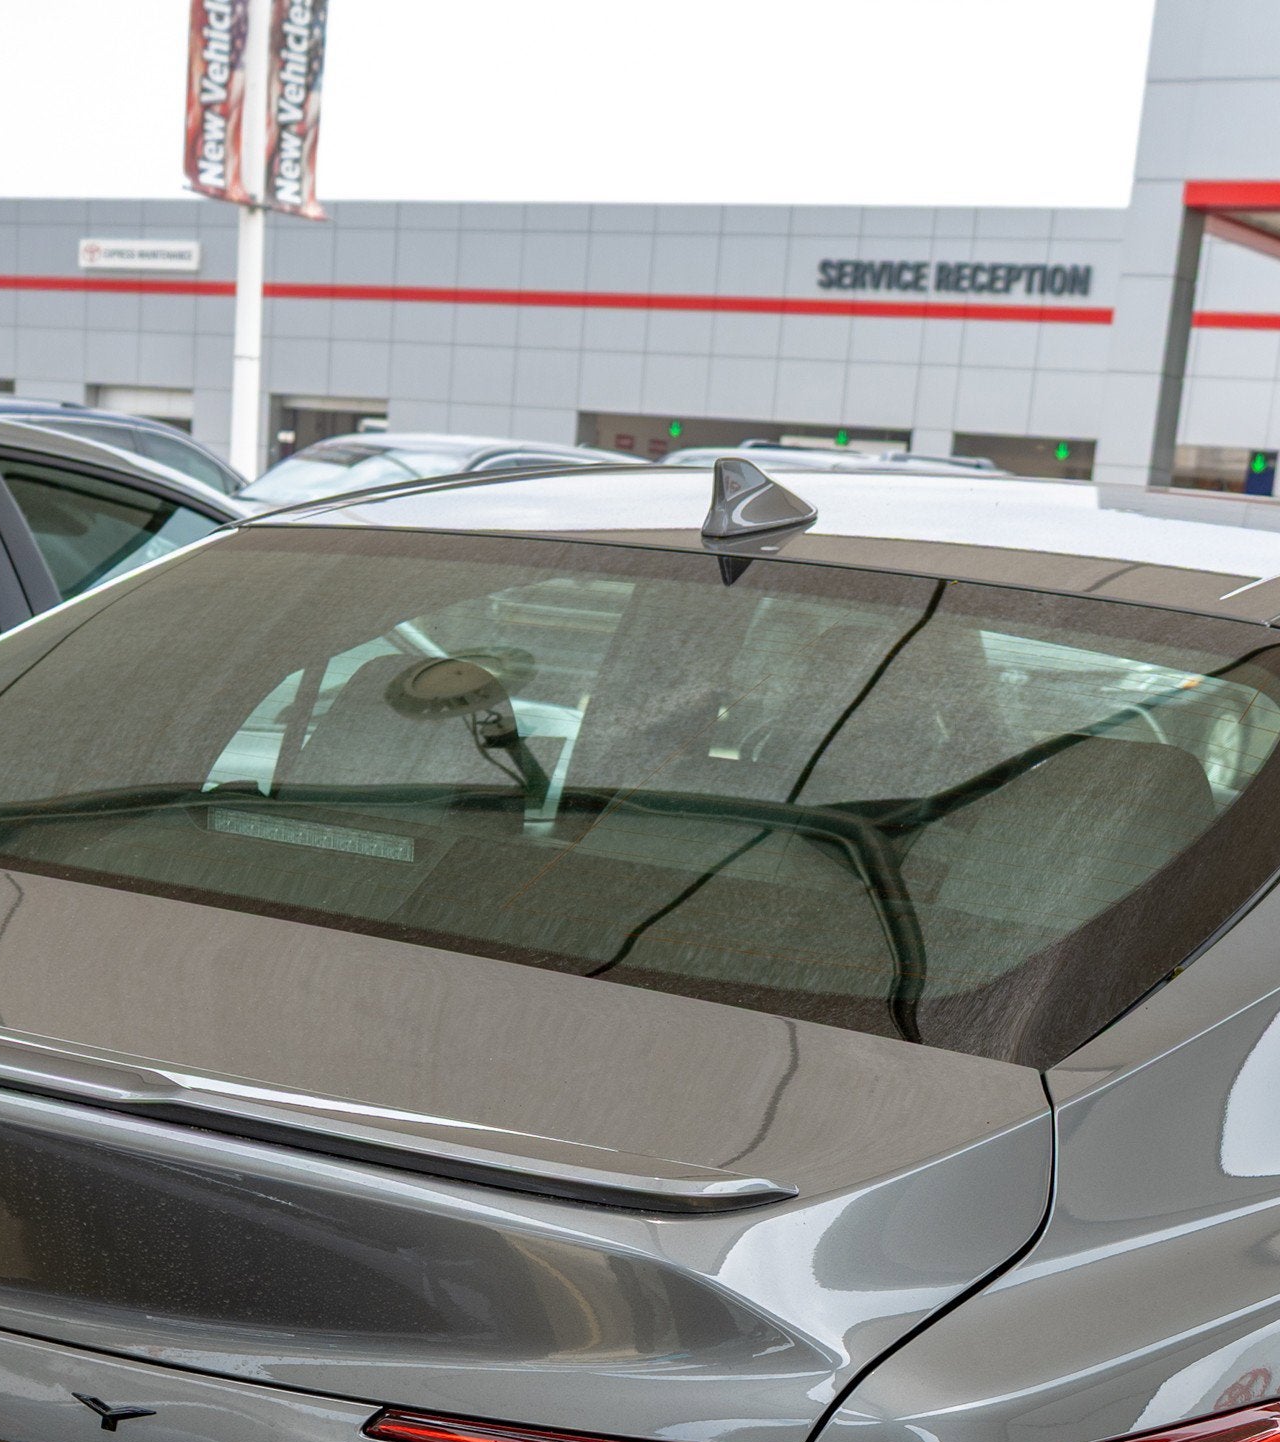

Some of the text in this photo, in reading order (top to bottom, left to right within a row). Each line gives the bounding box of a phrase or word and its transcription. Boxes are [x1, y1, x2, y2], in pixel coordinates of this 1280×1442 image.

[198, 112, 226, 190] New
[275, 131, 303, 204] New
[817, 259, 1093, 297] SERVICE RECEPTION
